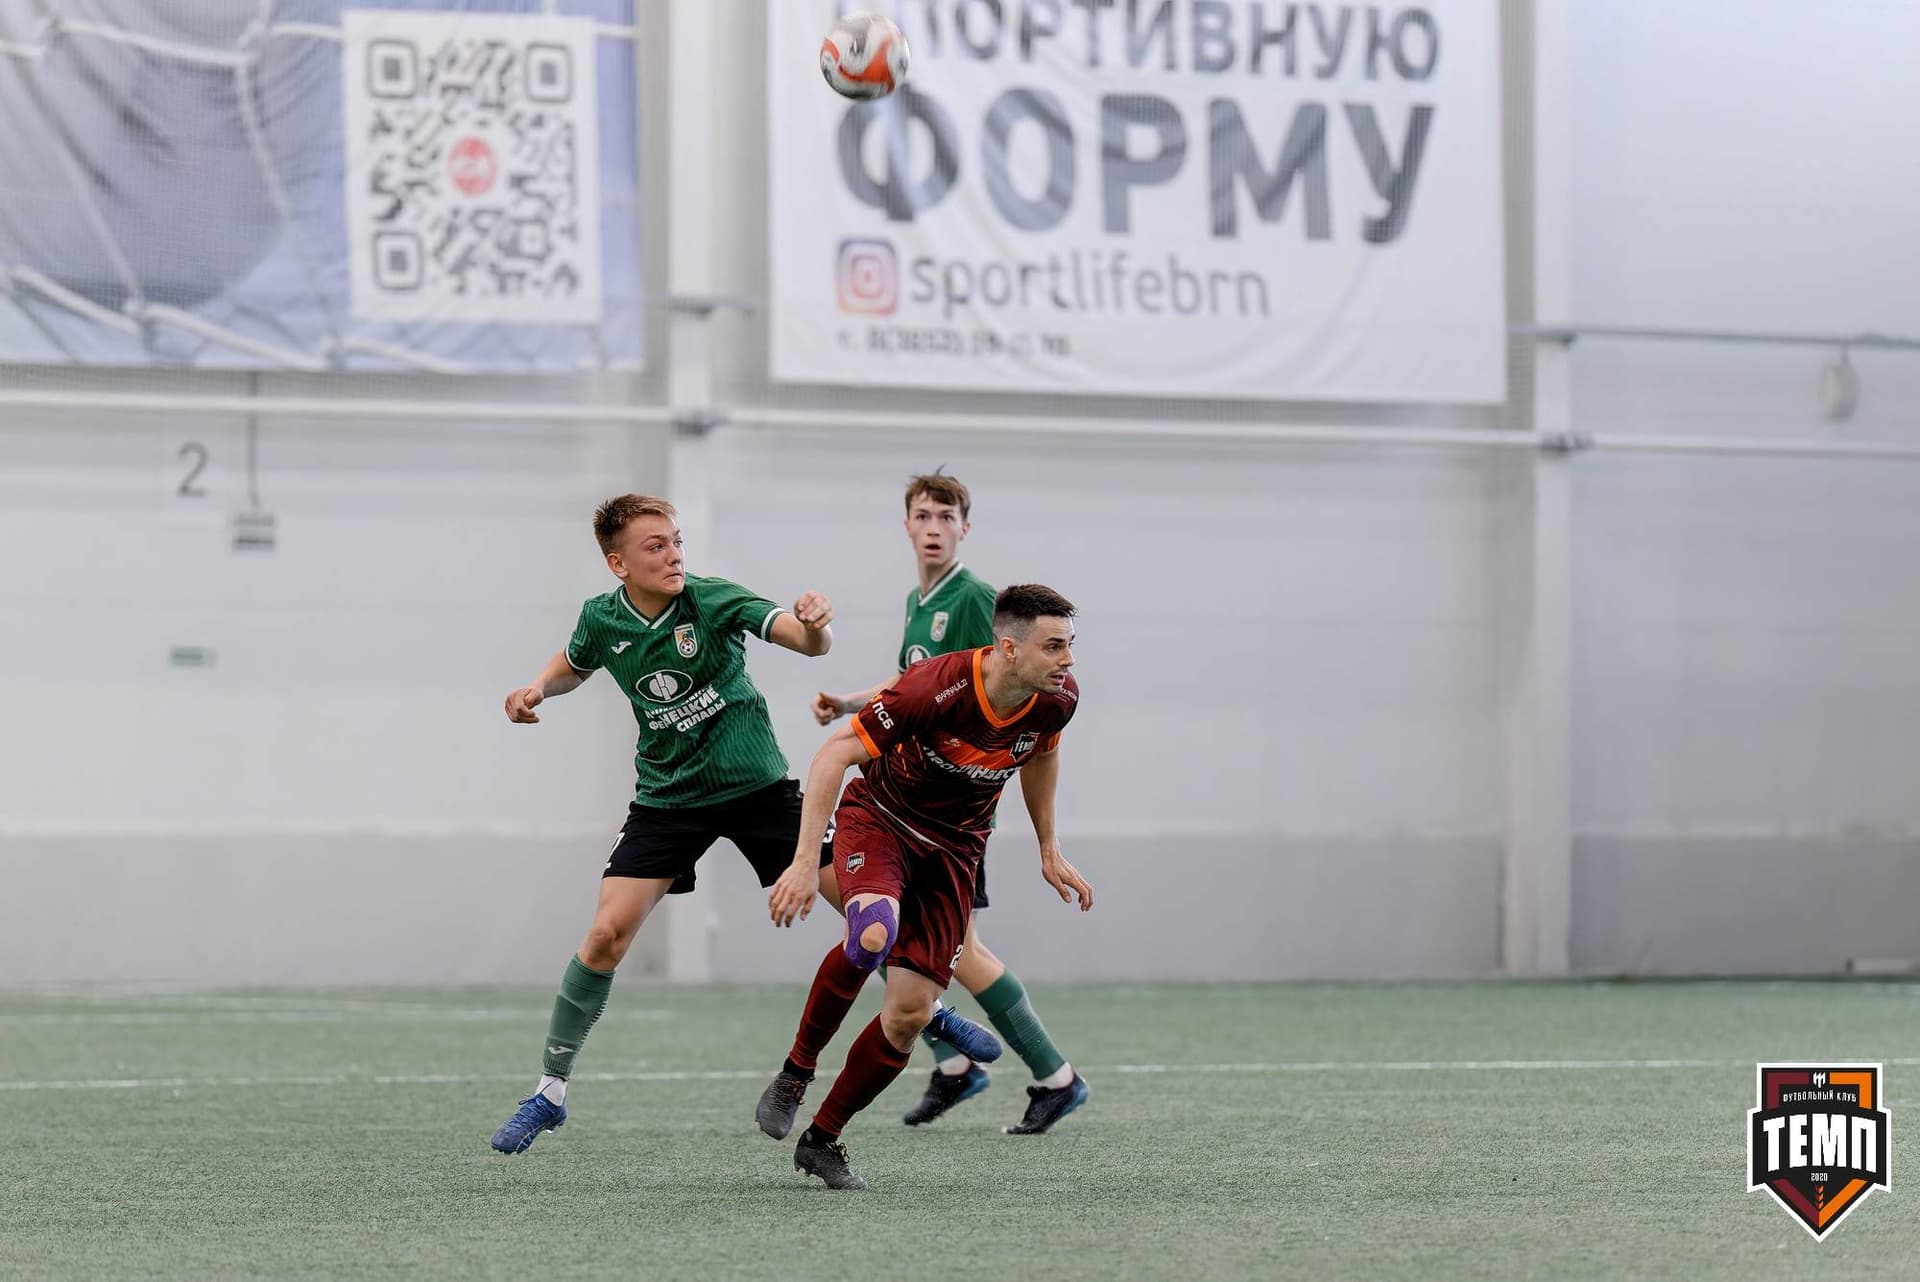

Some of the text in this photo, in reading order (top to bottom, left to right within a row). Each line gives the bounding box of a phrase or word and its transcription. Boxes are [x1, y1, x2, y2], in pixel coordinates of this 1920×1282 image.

[836, 83, 1437, 244] ФОРМУ
[909, 250, 1272, 318] sportlifebrn
[176, 441, 209, 499] 2
[871, 701, 895, 730] ПСБ
